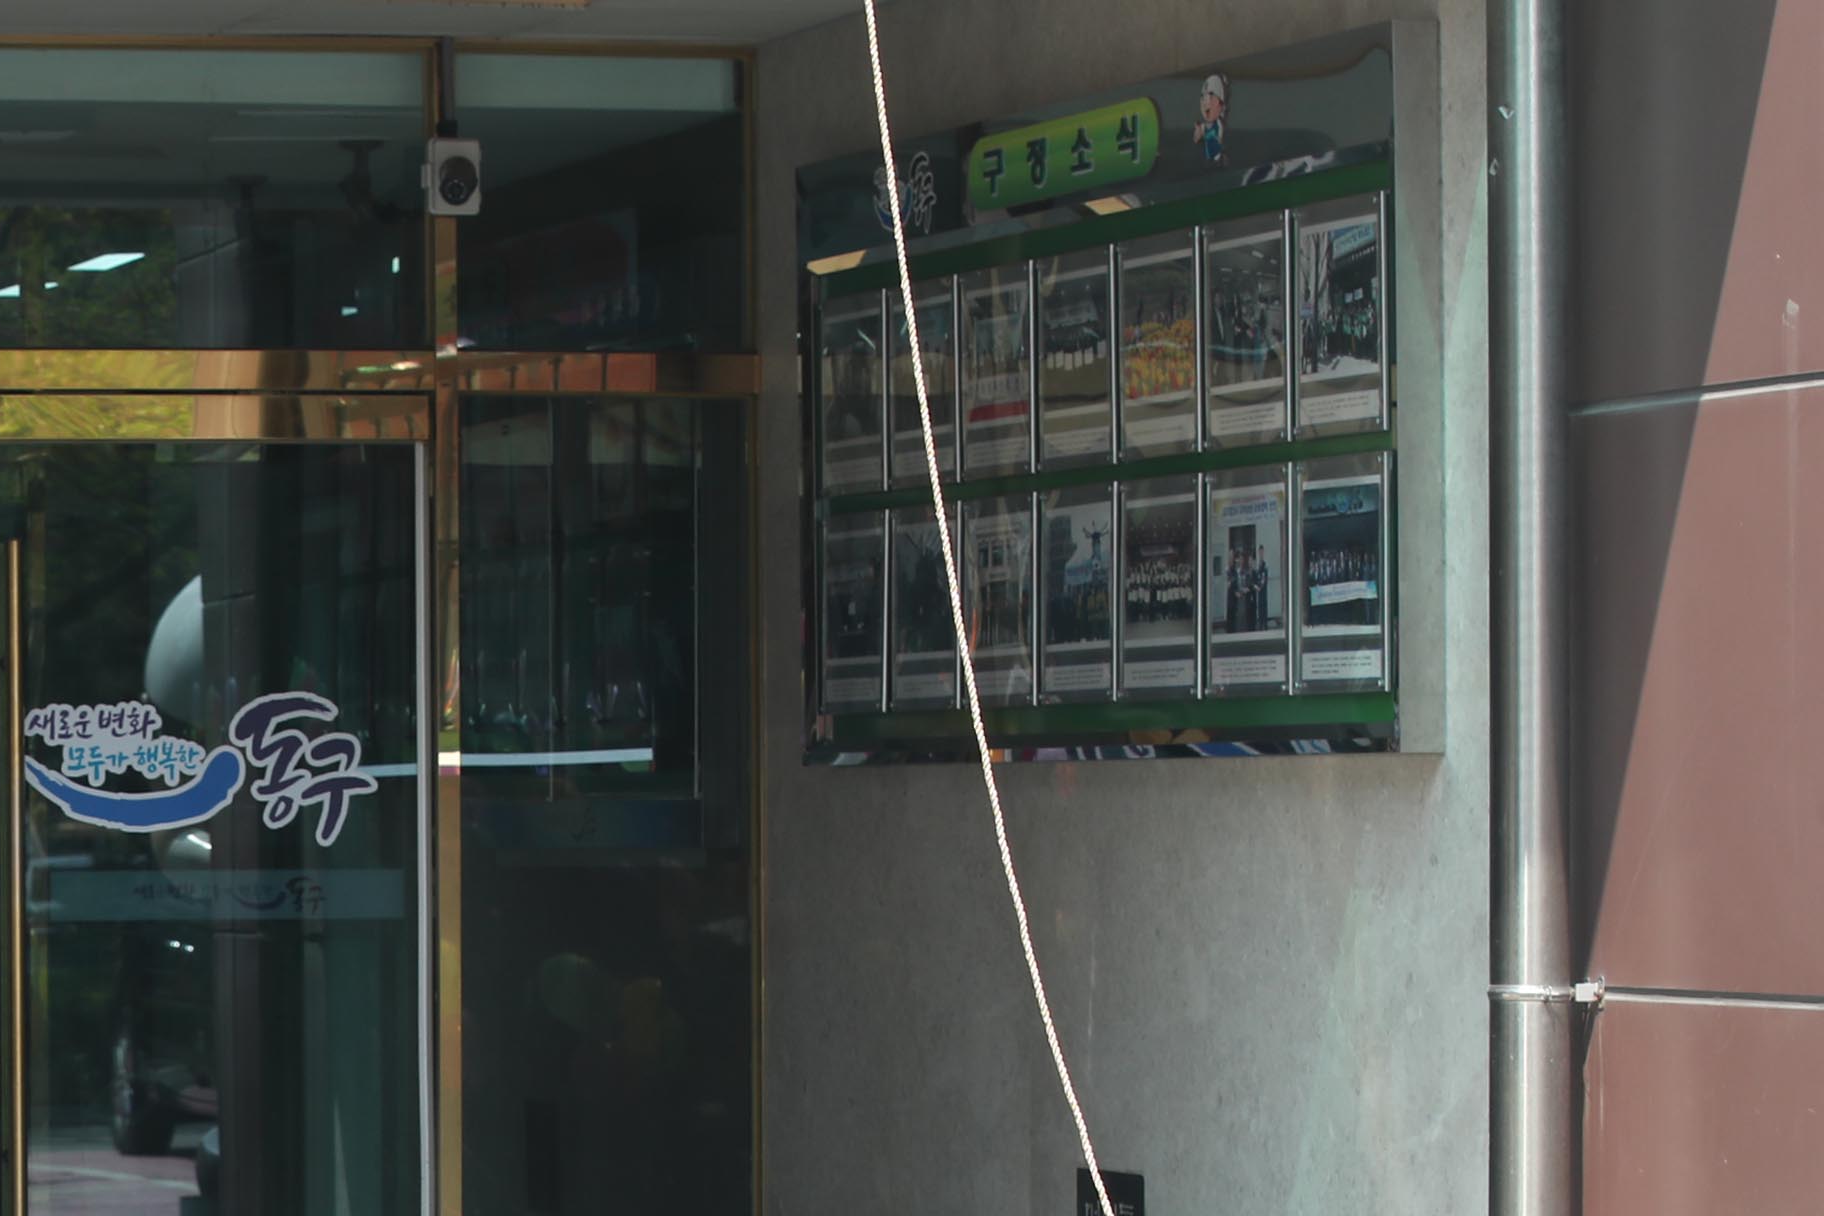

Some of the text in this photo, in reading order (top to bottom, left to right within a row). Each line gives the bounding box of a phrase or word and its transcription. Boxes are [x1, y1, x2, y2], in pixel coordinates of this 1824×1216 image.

[983, 113, 1140, 197] 구정소식
[28, 706, 157, 740] 새로운 변화
[67, 742, 200, 782] 모두가 행복한
[234, 697, 373, 841] 동구
